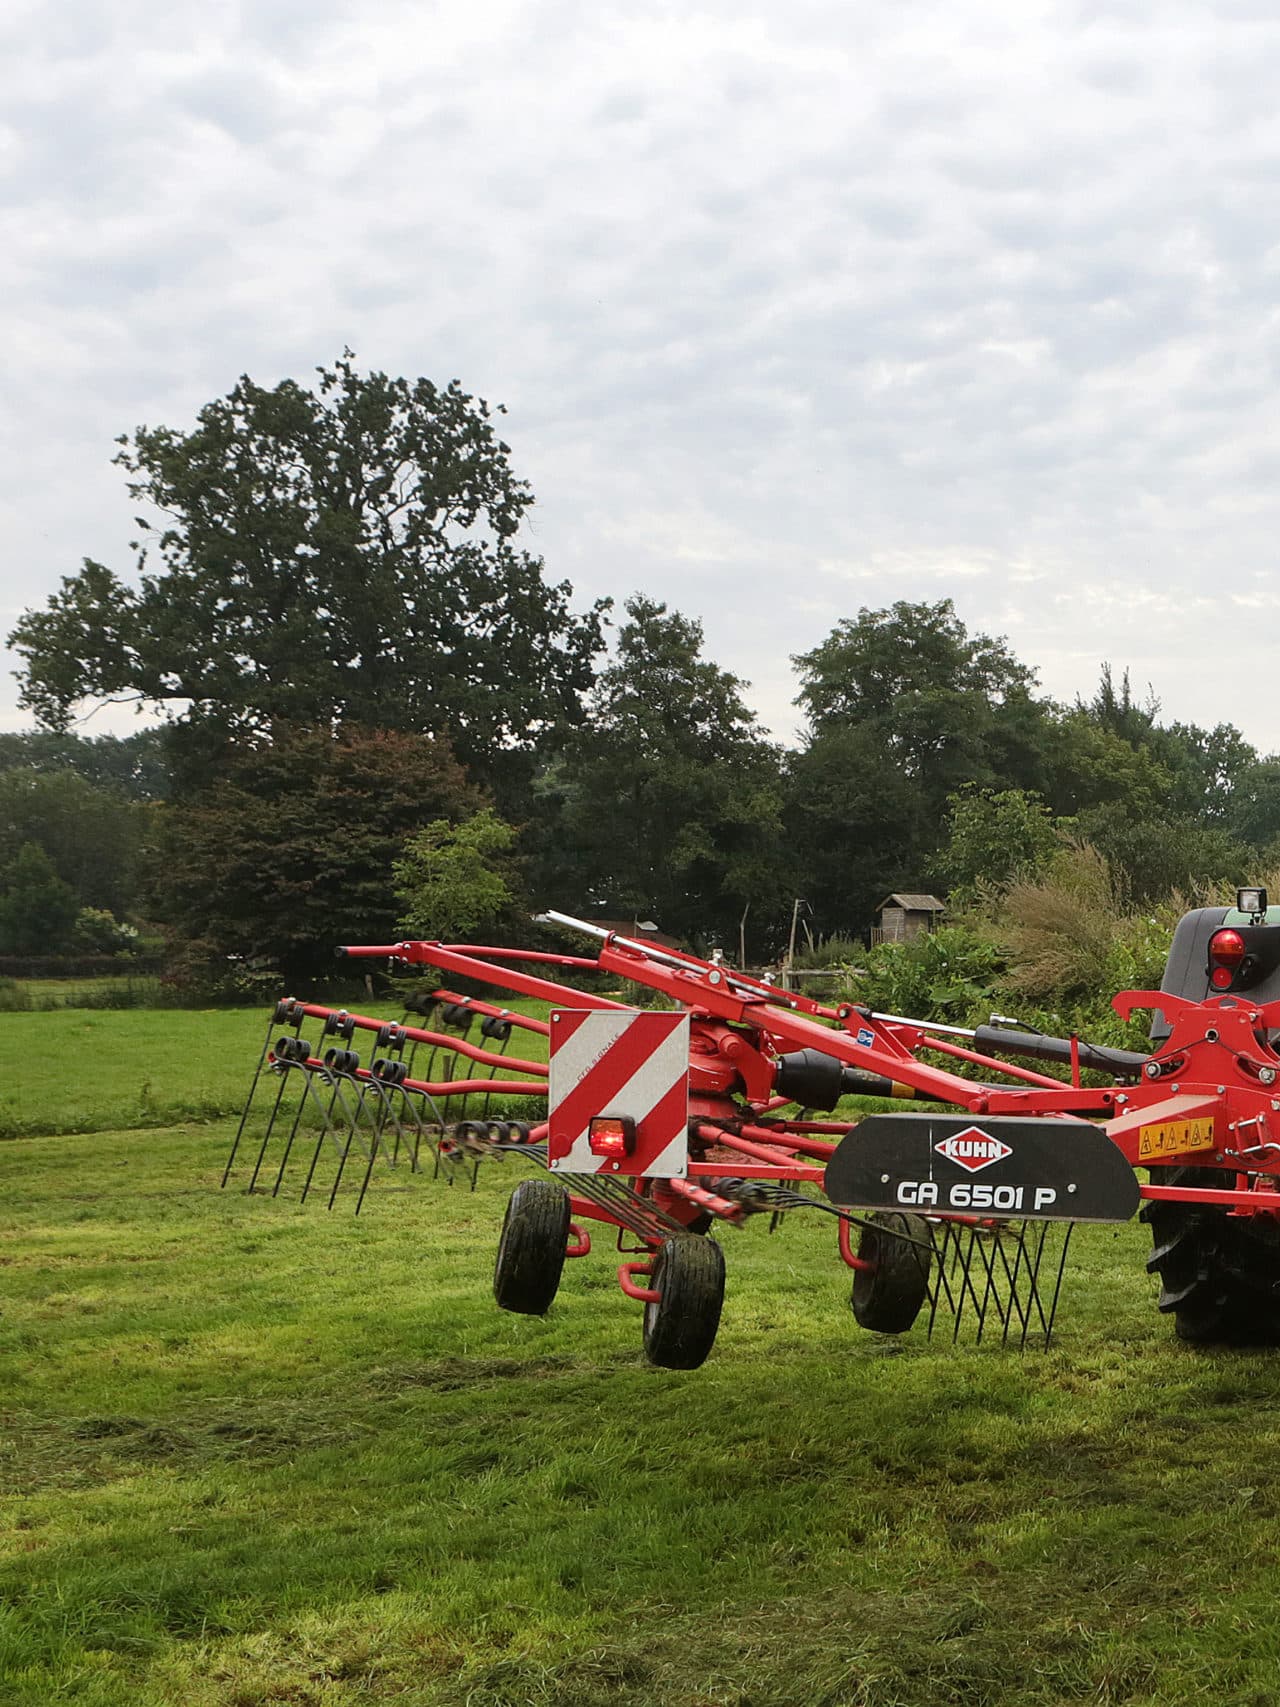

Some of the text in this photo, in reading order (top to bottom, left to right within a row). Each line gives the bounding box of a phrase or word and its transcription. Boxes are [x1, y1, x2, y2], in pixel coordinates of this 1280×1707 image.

[945, 1140, 1002, 1158] KUHN
[897, 1181, 1057, 1210] GA 6501 P
